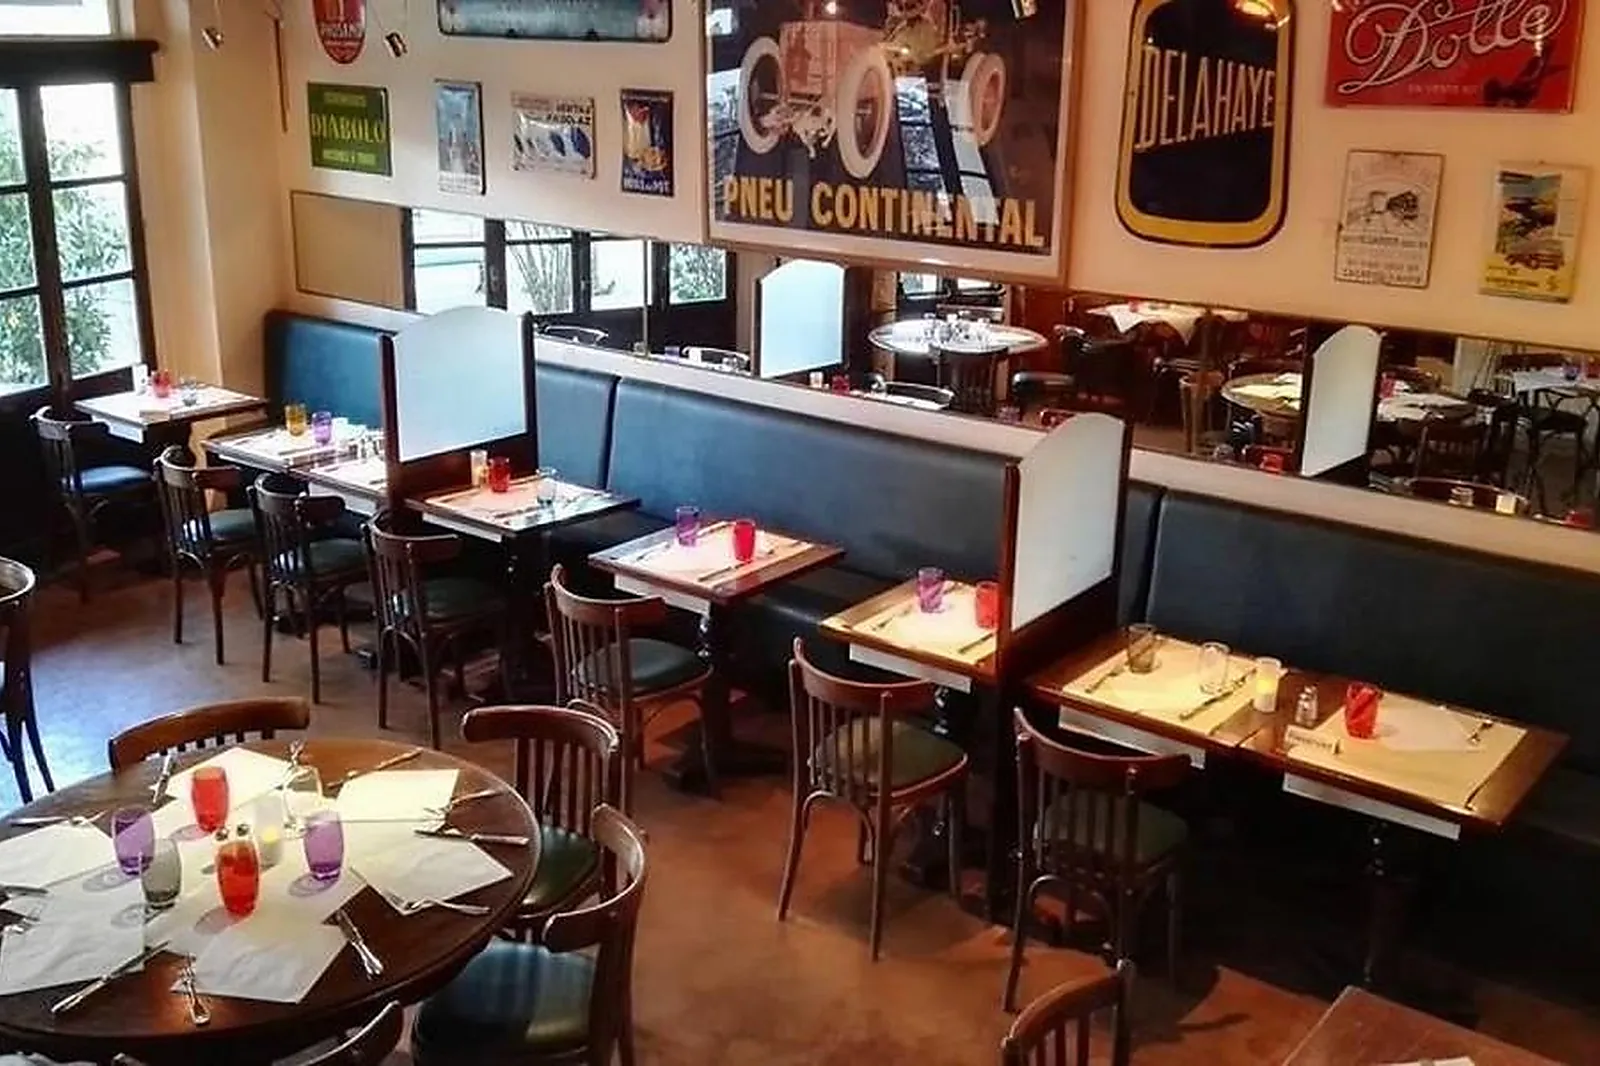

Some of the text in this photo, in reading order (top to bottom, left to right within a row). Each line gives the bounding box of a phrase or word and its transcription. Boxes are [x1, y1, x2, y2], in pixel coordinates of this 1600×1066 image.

[311, 113, 386, 143] DIABOLO
[1135, 45, 1276, 151] DELAHAYE
[725, 176, 1044, 247] PNEU CONTINENTAL
